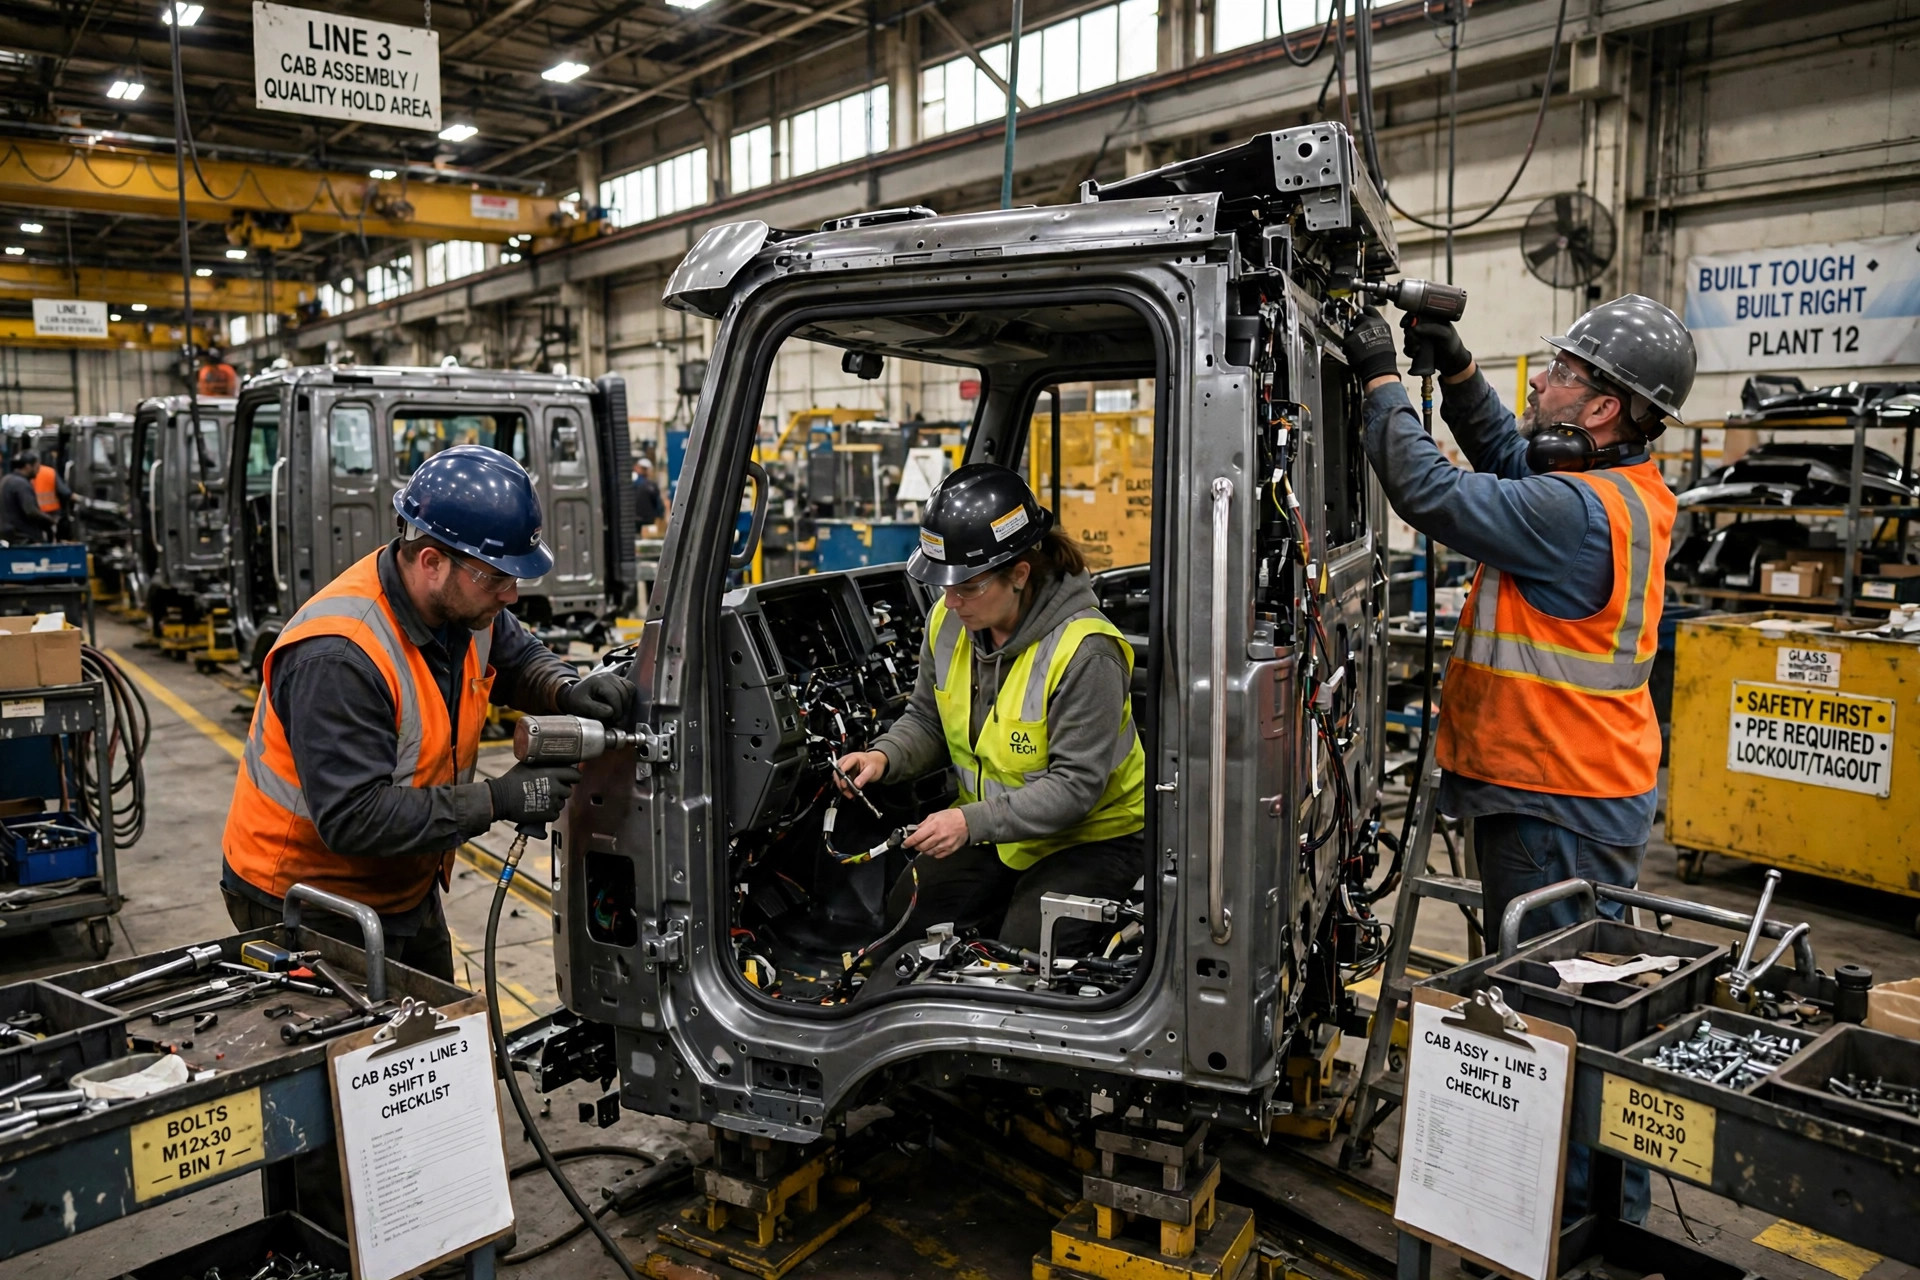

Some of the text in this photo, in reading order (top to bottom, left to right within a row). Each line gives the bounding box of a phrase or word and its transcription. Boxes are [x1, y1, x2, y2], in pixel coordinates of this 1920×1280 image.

[308, 20, 369, 58] LINE
[377, 32, 392, 61] 3
[280, 53, 317, 77] CAB
[321, 59, 408, 89] ASSEMBLY
[264, 77, 432, 119] QUALITY HOLD AREA
[1698, 254, 1856, 294] BUILT TOUGH
[1735, 285, 1868, 321] BUILT RIGHT
[1748, 325, 1860, 358] PLANT 12
[1747, 691, 1874, 729] SAFETY FIRST
[1009, 743, 1037, 756] TECH
[1011, 731, 1031, 744] QA
[1746, 717, 1876, 757] PPE REQUIRED
[1737, 741, 1883, 785] LOCKOUT/TAGOUT
[351, 1040, 469, 1090] CAB ASSY LINE 3
[1424, 1031, 1548, 1082] CAB ASSY LINE 3
[389, 1069, 437, 1097] SHIFT B
[1445, 1075, 1520, 1112] CHECKLIST
[1459, 1061, 1512, 1090] SHIFT B
[381, 1083, 451, 1119] CHECKLIST
[1629, 1087, 1686, 1121] BOLTS
[167, 1105, 228, 1139] BOLTS
[1622, 1107, 1687, 1145] M12x30
[162, 1126, 232, 1163] M12x30
[1633, 1133, 1679, 1164] BIN 7
[178, 1149, 226, 1180] BIN 7
